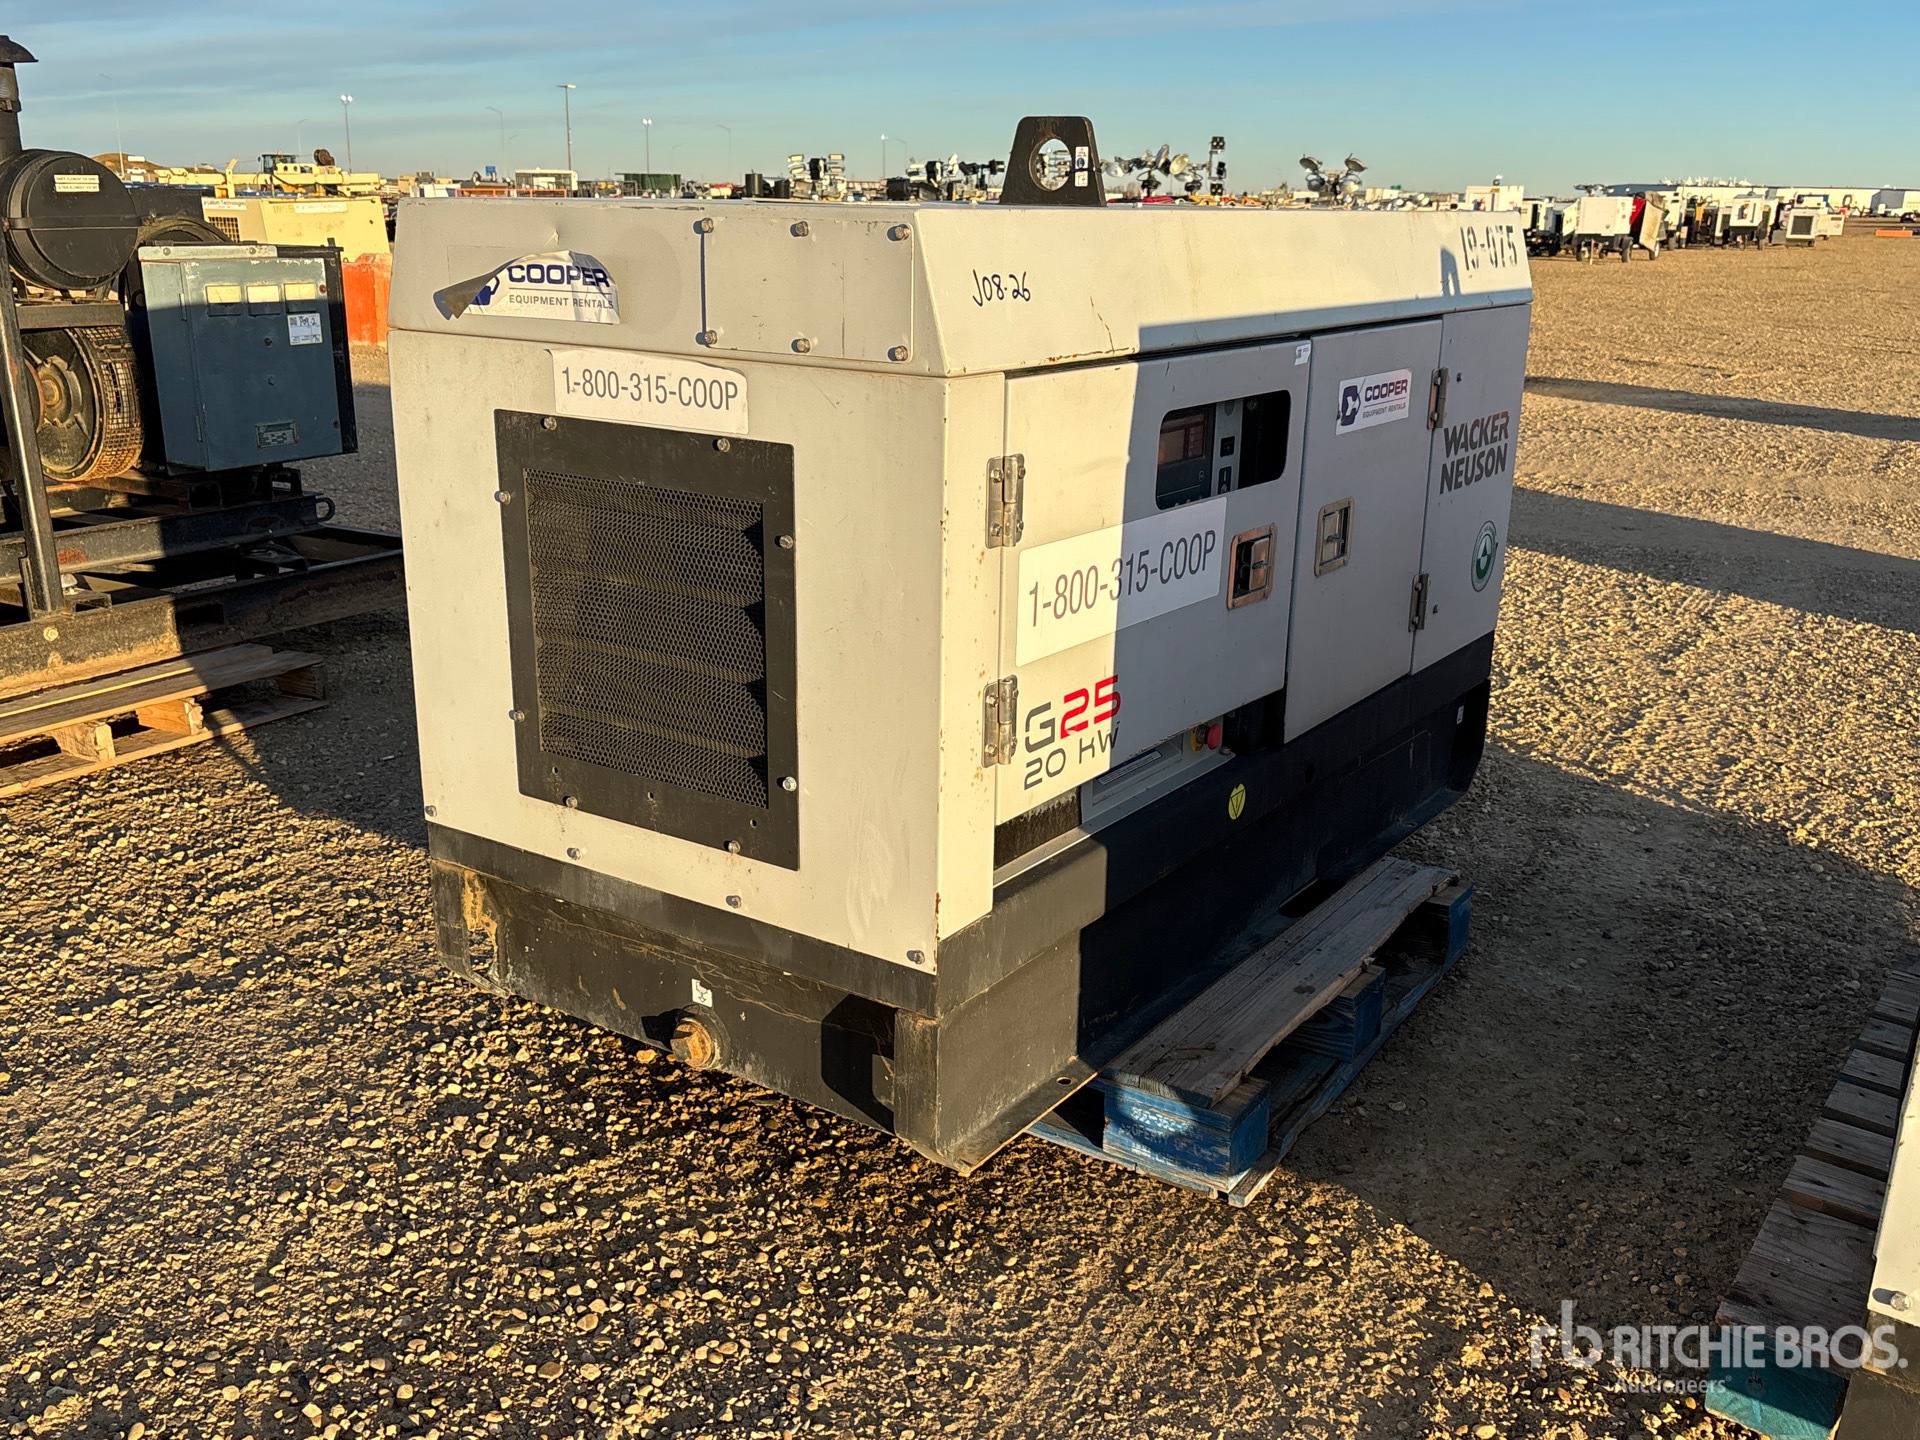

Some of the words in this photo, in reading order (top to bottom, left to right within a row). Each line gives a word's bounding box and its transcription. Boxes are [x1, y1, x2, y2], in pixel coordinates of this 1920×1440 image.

[1460, 225, 1518, 271] 19-075
[507, 263, 611, 288] COOPER
[509, 294, 569, 308] EQUIPMENT
[573, 297, 615, 310] RENTALS
[562, 366, 739, 411] 1-800-315-COOP
[1362, 406, 1388, 419] EQUIPMENT
[1388, 402, 1407, 413] RENTALS
[1364, 379, 1409, 402] COOPER
[1444, 410, 1510, 459] WACKER
[1439, 443, 1508, 495] NEUSON
[1029, 529, 1217, 628] 1-800-315-COOP
[1025, 674, 1122, 754] G25
[1024, 747, 1067, 791] 20
